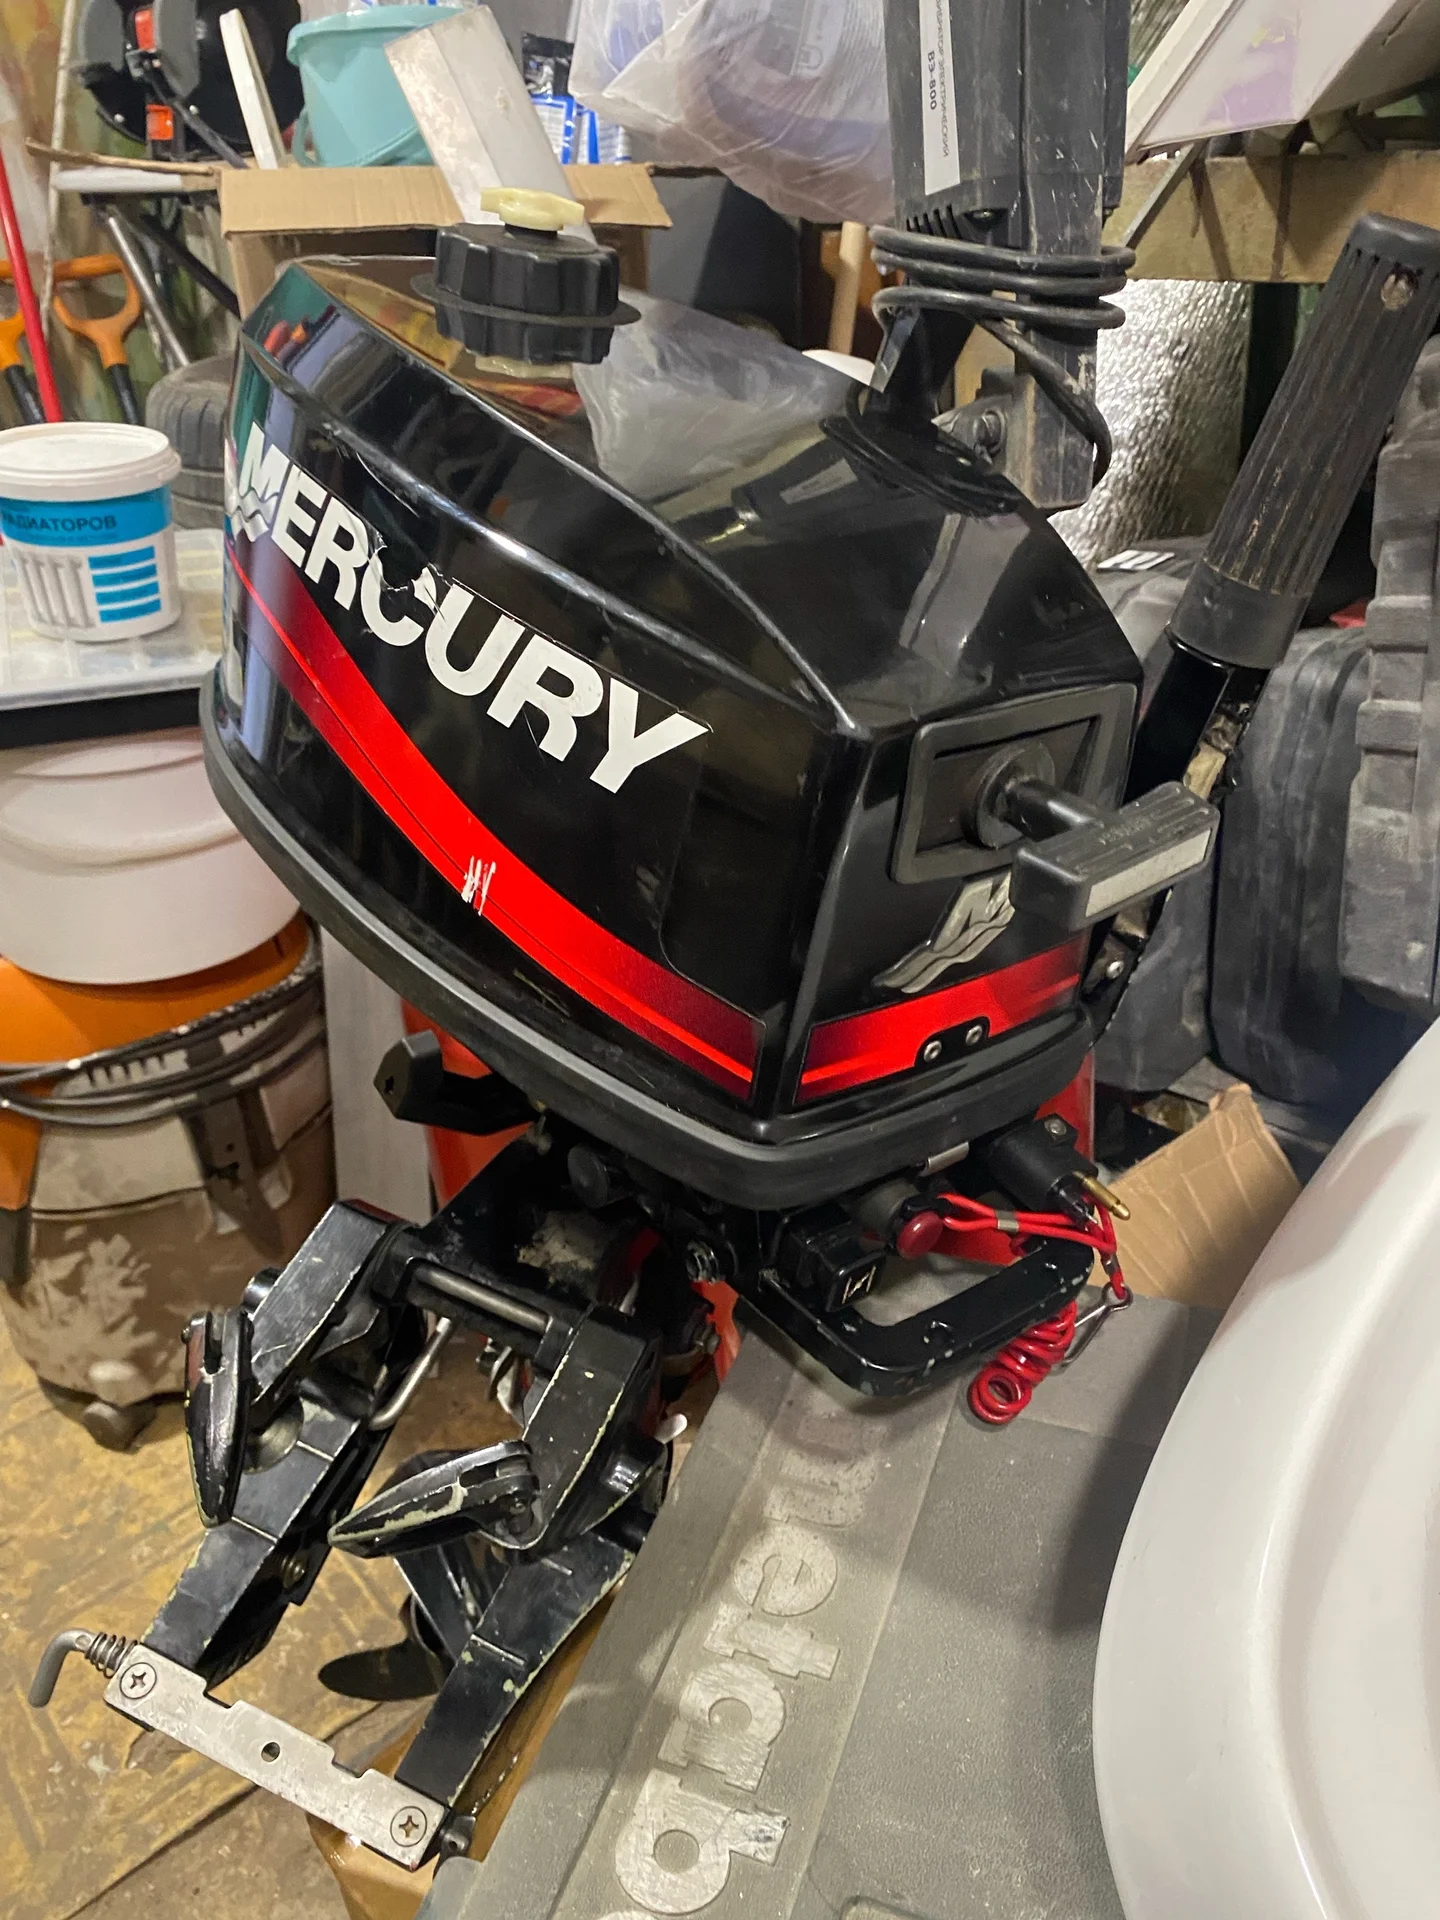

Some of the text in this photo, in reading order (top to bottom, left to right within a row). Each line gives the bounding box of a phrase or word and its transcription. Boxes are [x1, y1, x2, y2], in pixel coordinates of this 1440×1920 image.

[927, 51, 938, 111] ВЭ-800
[937, 60, 949, 157] ЭЛЕКТРИЧЕСКИЙ
[225, 421, 711, 795] MERCURY
[597, 1416, 889, 1920] metab
